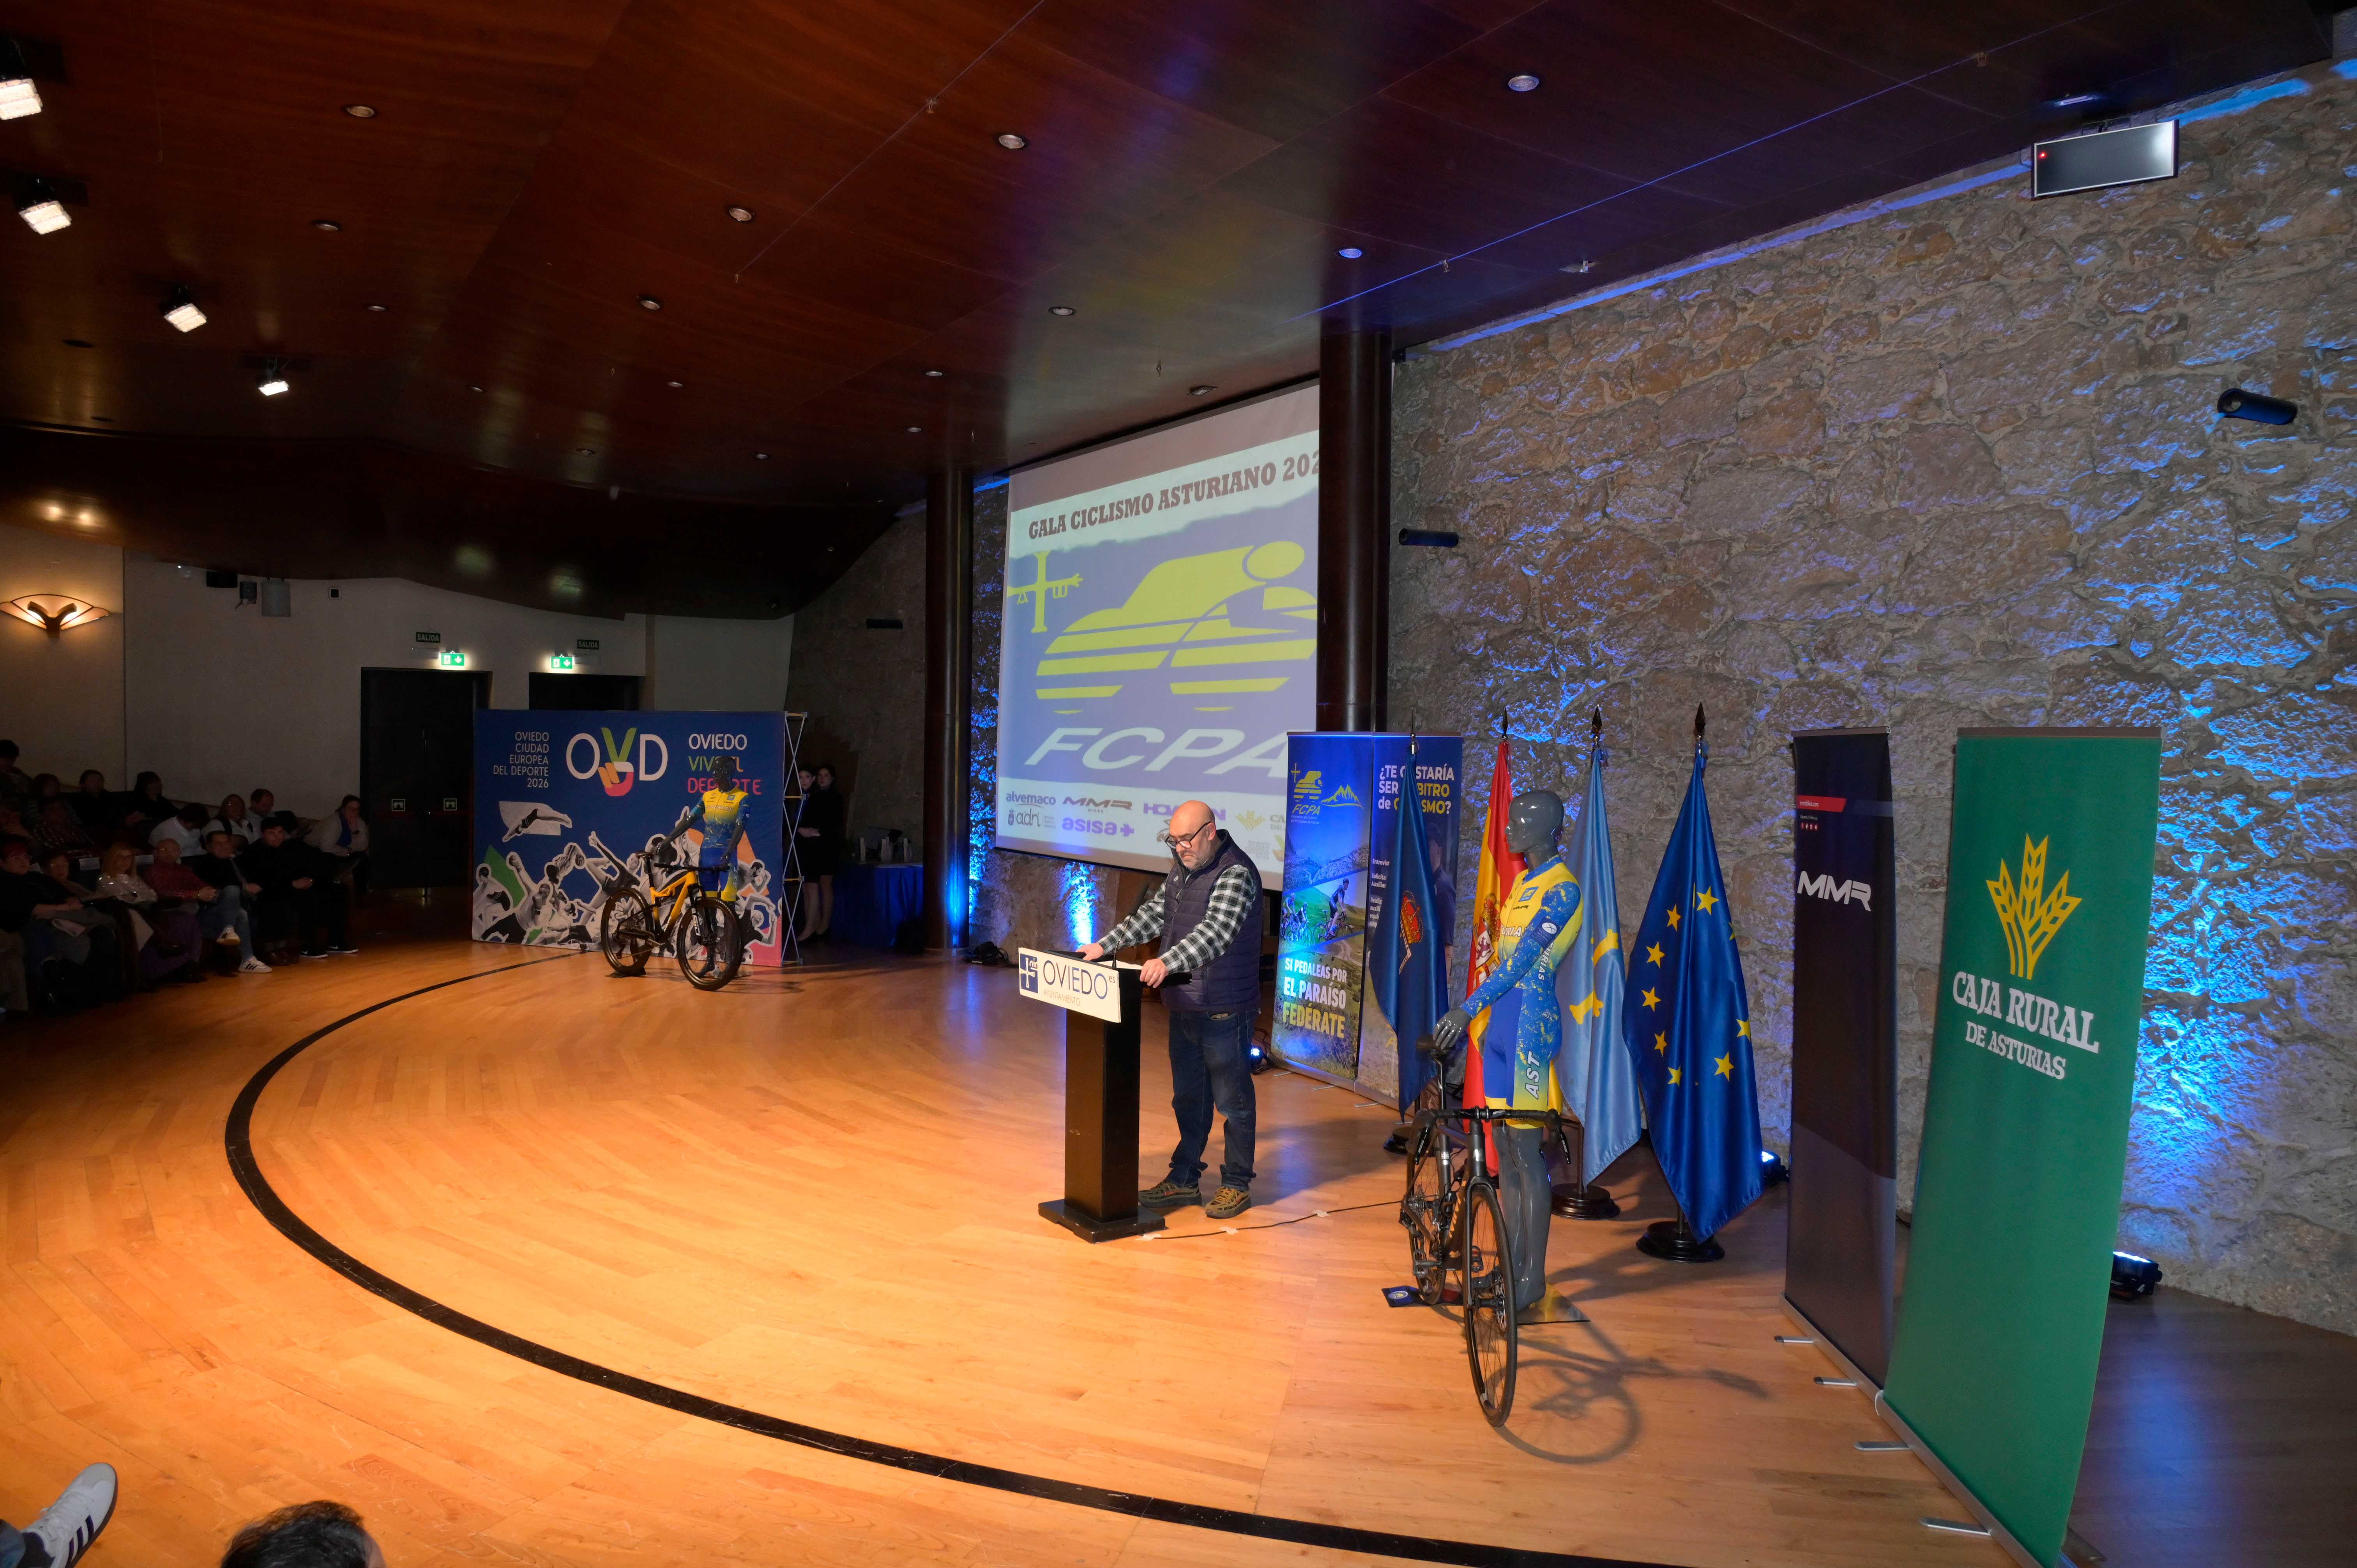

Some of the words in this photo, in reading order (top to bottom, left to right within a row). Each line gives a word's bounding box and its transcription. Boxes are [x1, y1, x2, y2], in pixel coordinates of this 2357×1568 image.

[1028, 514, 1067, 539] GALA
[1071, 493, 1154, 530] CICLISMO
[1158, 462, 1276, 510] ASTURIANO
[417, 633, 440, 642] SALIDA
[578, 640, 599, 649] SALIDA
[515, 731, 549, 741] OVIEDO
[688, 733, 747, 750] OVIEDO
[515, 743, 549, 753] CIUDAD
[1024, 727, 1316, 778] FCPA
[509, 754, 549, 765] EUROPEA
[493, 765, 508, 775] DEL
[511, 766, 549, 777] DEPORTE
[1379, 765, 1397, 780] ¿TE
[527, 778, 549, 788] 2026
[687, 777, 762, 795] DEPTE
[1379, 780, 1398, 794] SER
[1417, 782, 1450, 797] BITRO
[1006, 791, 1056, 805] alvemaco
[1062, 796, 1133, 810] MMR
[1378, 796, 1391, 810] de
[1292, 804, 1320, 815] FCPA
[1270, 814, 1285, 823] CA
[1797, 871, 1871, 912] MMR
[1285, 957, 1293, 971] SI
[1294, 959, 1330, 979] PEDALEAS
[1332, 968, 1347, 983] POR
[1044, 989, 1081, 1006] AYUNTAMIENTO
[1283, 976, 1296, 997] EL
[1299, 982, 1346, 1009] PARAÍSO
[1282, 1001, 1345, 1038] FEDÉRATE
[1953, 971, 2002, 1019] CAJA
[2006, 987, 2100, 1053] RURAL
[1965, 1021, 1985, 1048] DE
[1988, 1031, 2066, 1081] ASTURIAS
[1525, 1050, 1541, 1100] AST
